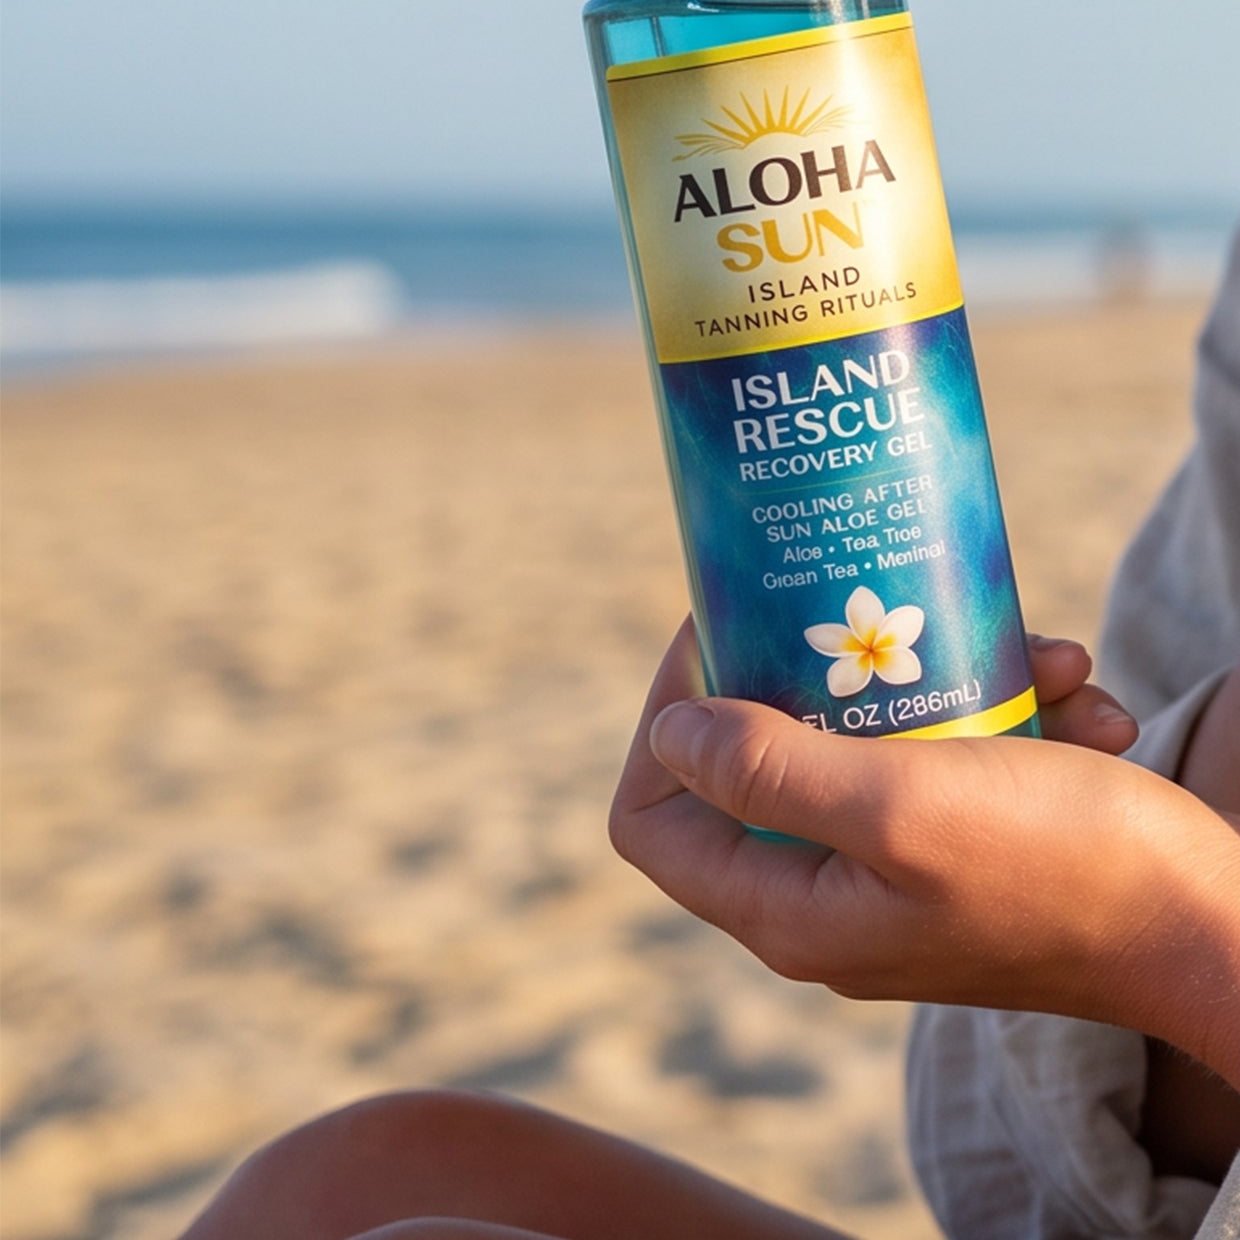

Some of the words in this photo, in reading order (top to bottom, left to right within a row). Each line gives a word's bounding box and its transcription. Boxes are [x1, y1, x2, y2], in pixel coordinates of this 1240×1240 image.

[673, 138, 897, 223] ALOHA
[716, 200, 865, 273] SUN
[694, 304, 809, 338] TANNING
[820, 282, 918, 318] RITUALS
[747, 266, 861, 304] ISLAND
[731, 349, 911, 412] ISLAND
[733, 386, 926, 454] RESCUE
[739, 440, 878, 482] RECOVERY
[887, 430, 934, 457] GEL
[752, 492, 854, 524] COOLING
[863, 474, 933, 505] AFTER
[766, 522, 812, 543] SUN
[821, 509, 879, 535] ALOE
[886, 498, 930, 521] GEL
[783, 546, 823, 564] Aloe
[842, 535, 880, 553] Tea
[823, 562, 859, 581] Tea
[843, 703, 881, 730] OZ
[888, 678, 982, 727] (286mL)
